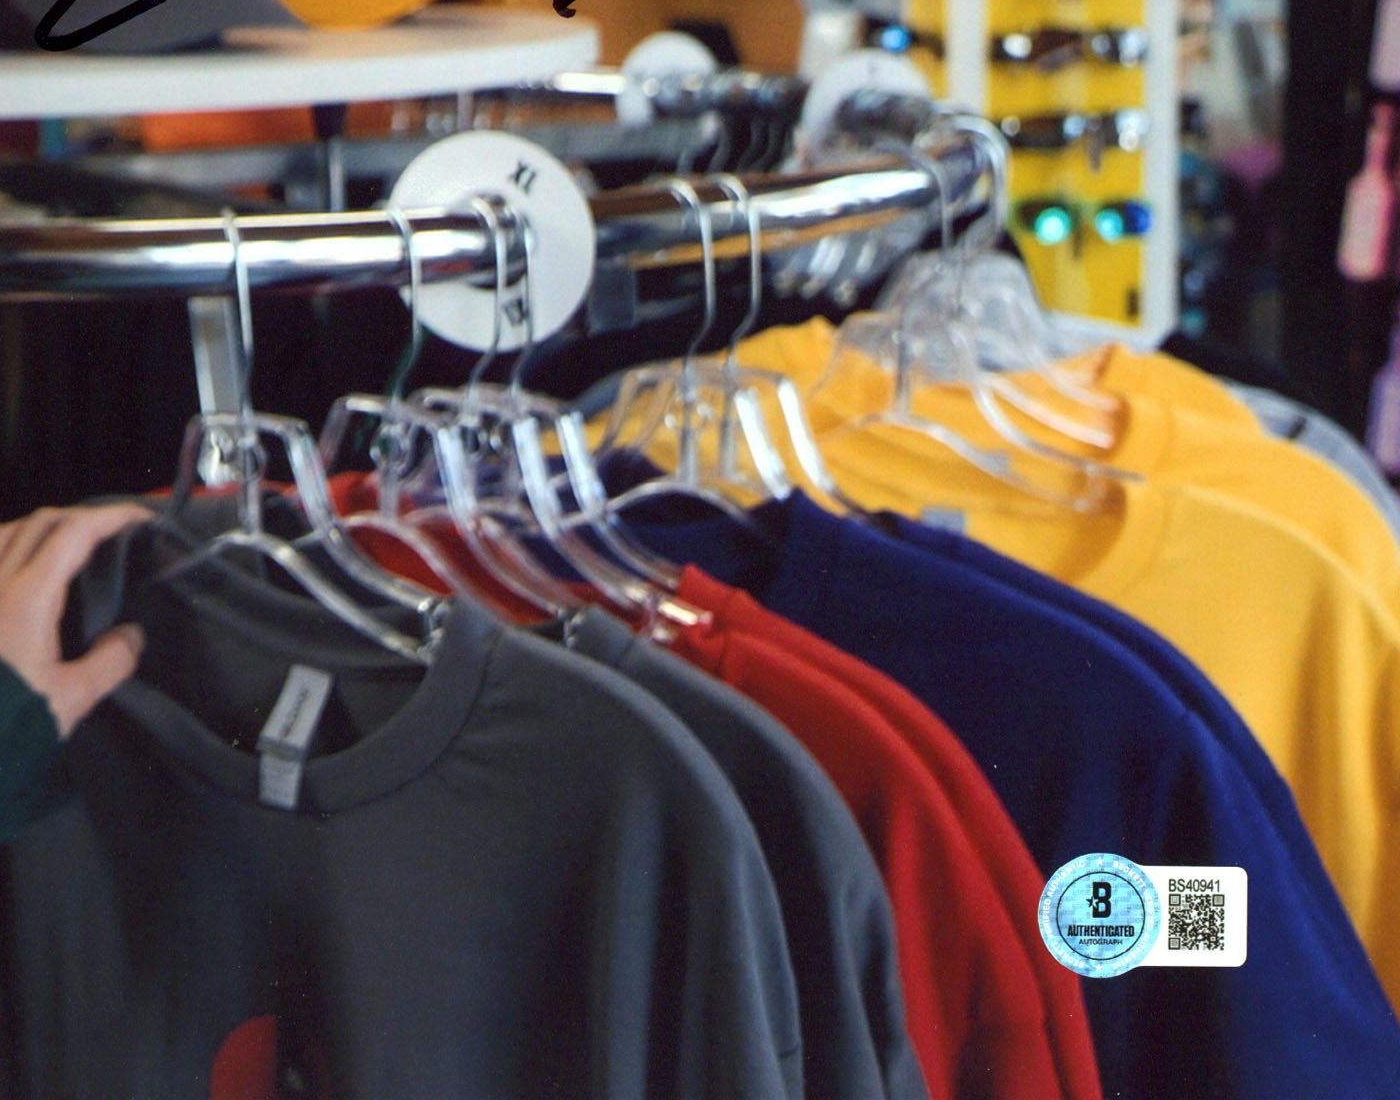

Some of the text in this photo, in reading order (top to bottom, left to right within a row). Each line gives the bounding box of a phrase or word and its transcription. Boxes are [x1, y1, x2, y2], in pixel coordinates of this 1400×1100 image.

[1168, 878, 1220, 893] BS40941
[1067, 925, 1135, 937] AUTHENTICATED
[1078, 938, 1123, 946] AUTOGRAPH
